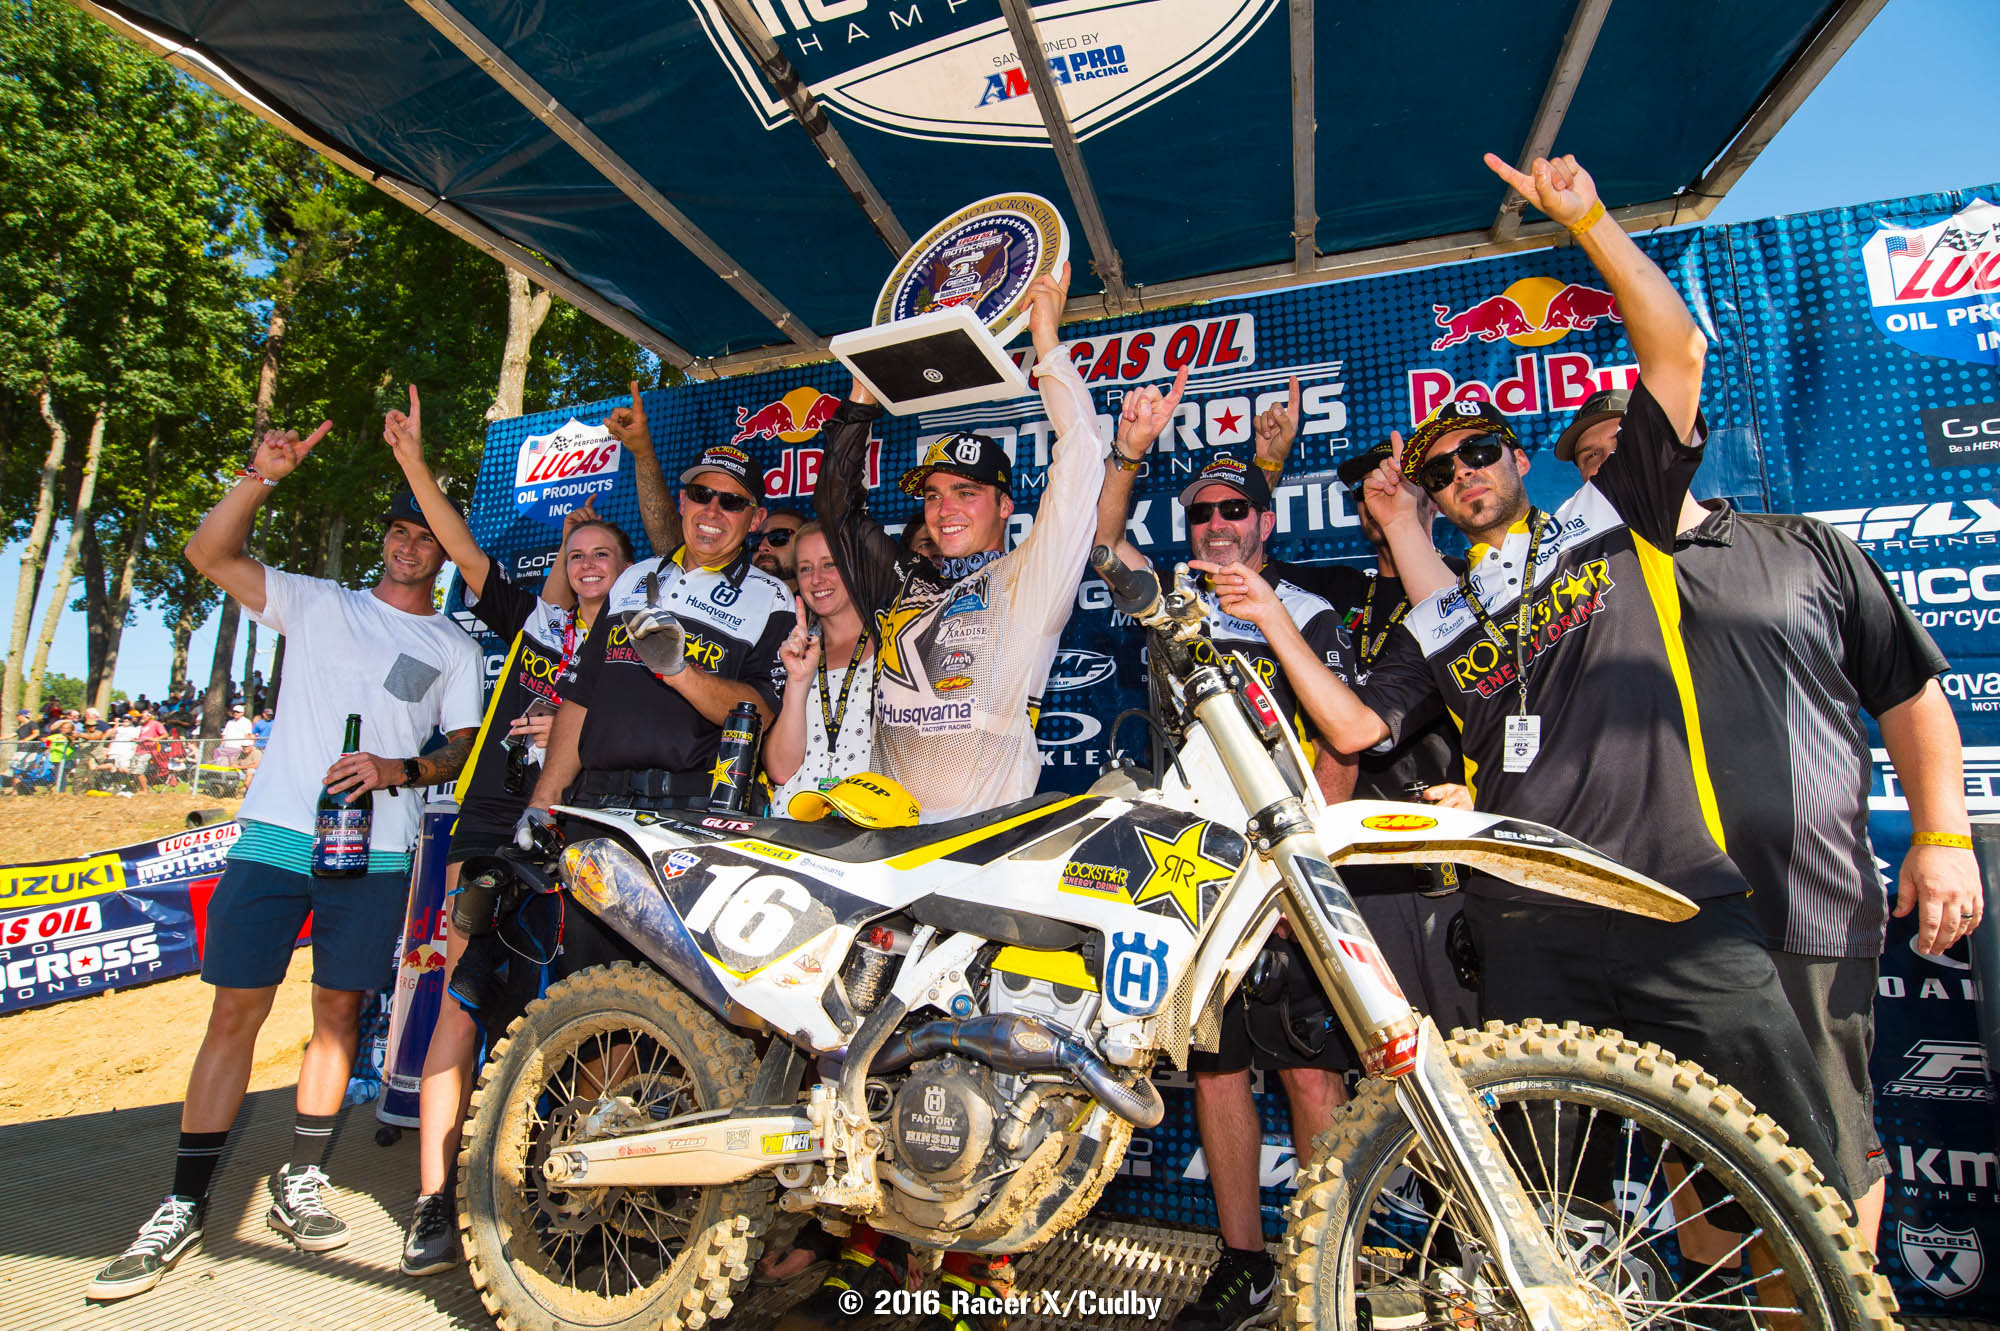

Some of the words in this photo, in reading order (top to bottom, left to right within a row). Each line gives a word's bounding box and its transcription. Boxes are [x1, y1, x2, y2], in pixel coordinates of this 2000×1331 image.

[992, 34, 1078, 68] SANONED
[1081, 32, 1100, 46] BY
[1072, 44, 1126, 72] PRO
[1074, 64, 1129, 82] RACING
[925, 222, 954, 249] PRO
[956, 199, 1038, 225] MOTOCROSS
[1035, 206, 1058, 276] CHAMPION
[1886, 312, 1938, 333] OIL
[1163, 318, 1244, 372] OIL
[1408, 353, 1541, 427] Red
[1949, 445, 1962, 453] Be
[525, 444, 617, 483] LUCAS
[517, 490, 539, 504] OIL
[542, 479, 613, 500] PRODUCTS
[1861, 533, 1996, 551] RACING
[686, 594, 743, 627] Husqvarna
[1547, 591, 1602, 642] DRINK
[940, 619, 987, 642] PARADISE
[882, 702, 972, 726] Husqvarna
[921, 724, 947, 734] FACTORY
[948, 722, 972, 732] RACING
[1038, 749, 1127, 766] KLEY
[844, 777, 891, 798] NLOP
[702, 817, 754, 832] GUTS
[1364, 815, 1437, 829] FMF
[164, 831, 210, 853] LUCAS
[215, 826, 238, 841] OIL
[1064, 861, 1129, 885] ROCKSTAR
[1064, 876, 1095, 888] ENERGY
[1095, 881, 1120, 893] DRINK
[38, 906, 93, 938] OIL
[684, 864, 813, 957] 16
[911, 1112, 957, 1127] FACTORY
[905, 1130, 961, 1147] HINSON
[1905, 1233, 1973, 1248] RACER
[1923, 1249, 1967, 1286] X
